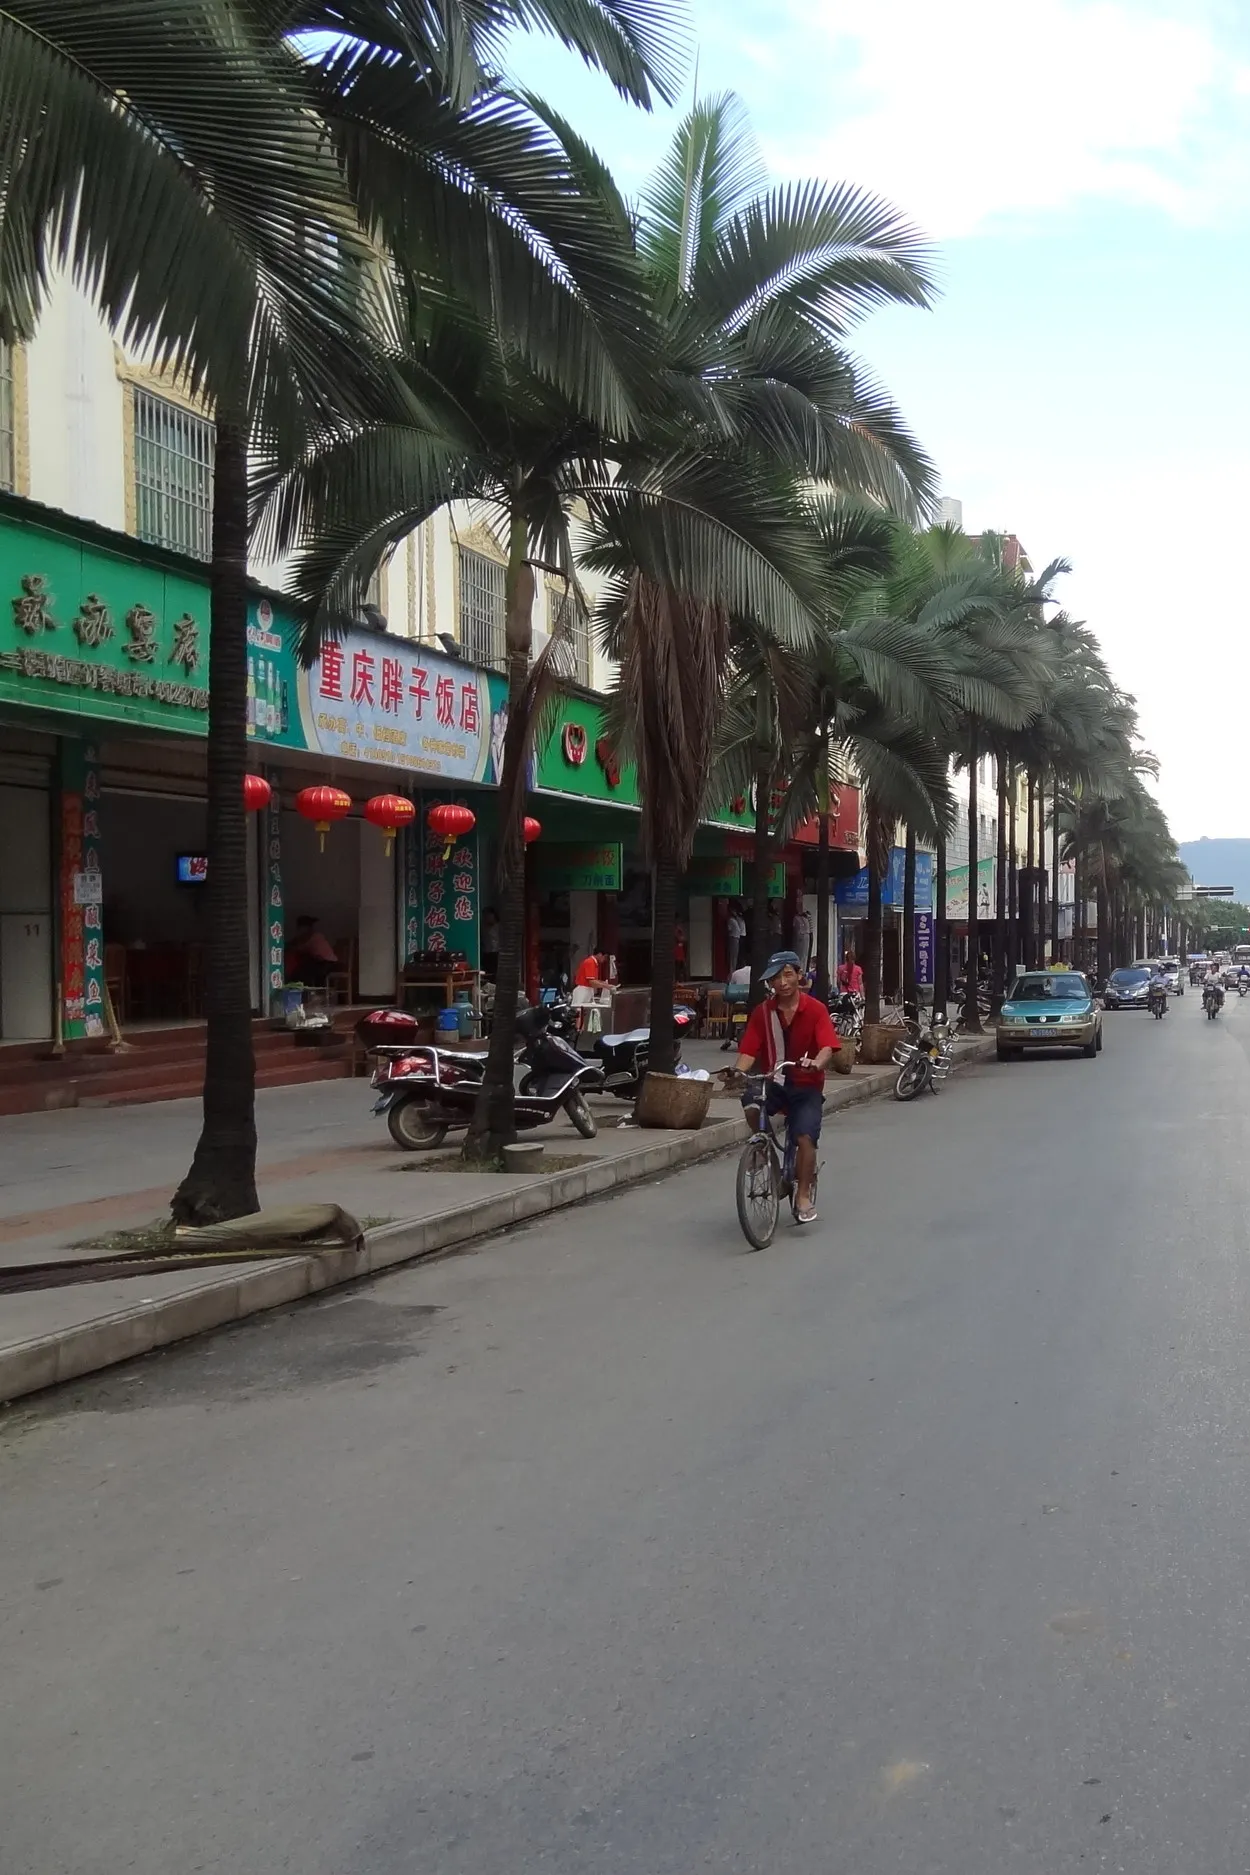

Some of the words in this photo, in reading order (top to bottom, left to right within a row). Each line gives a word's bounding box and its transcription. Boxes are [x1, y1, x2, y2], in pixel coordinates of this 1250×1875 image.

[318, 640, 481, 737] 重庆胖子饭店
